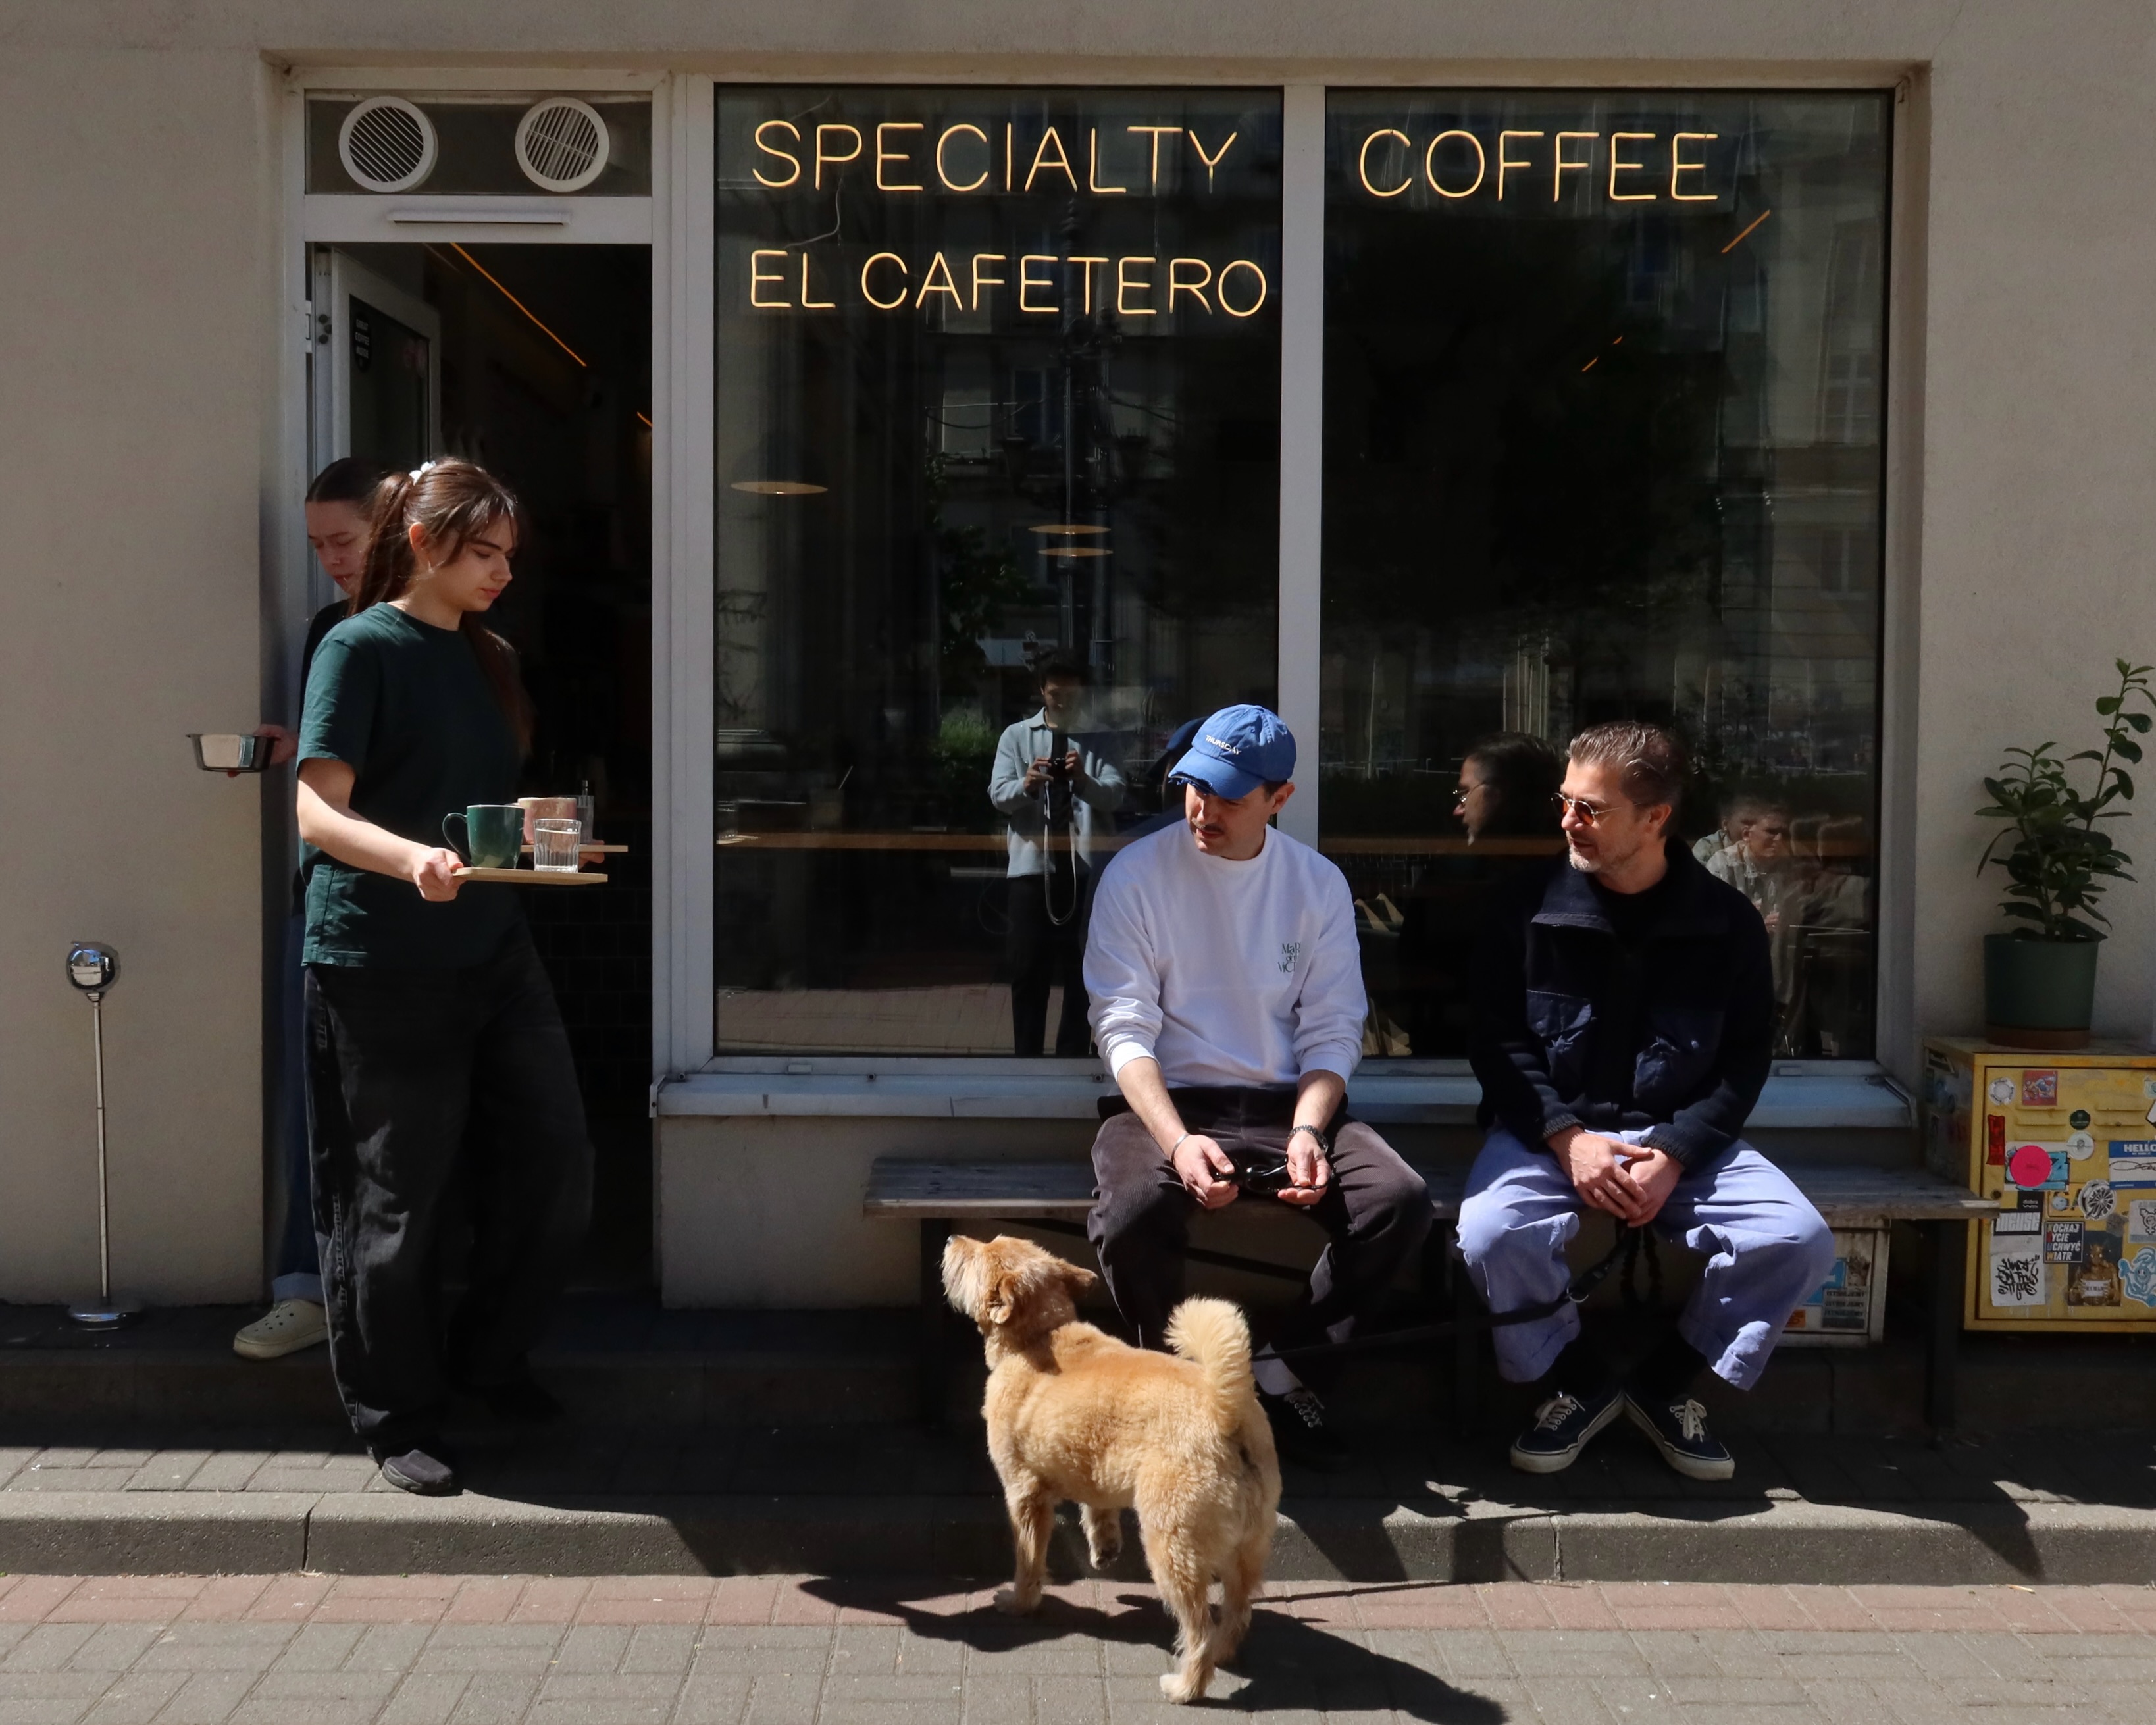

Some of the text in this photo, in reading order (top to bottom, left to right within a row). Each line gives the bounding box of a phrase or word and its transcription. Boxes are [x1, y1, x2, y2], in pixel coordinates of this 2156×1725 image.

[752, 120, 1718, 203] SPECIALTY COFFEE
[750, 249, 1267, 317] EL CAFETERO
[1205, 734, 1242, 755] THURSDAY
[2047, 1251, 2072, 1261] WIATR
